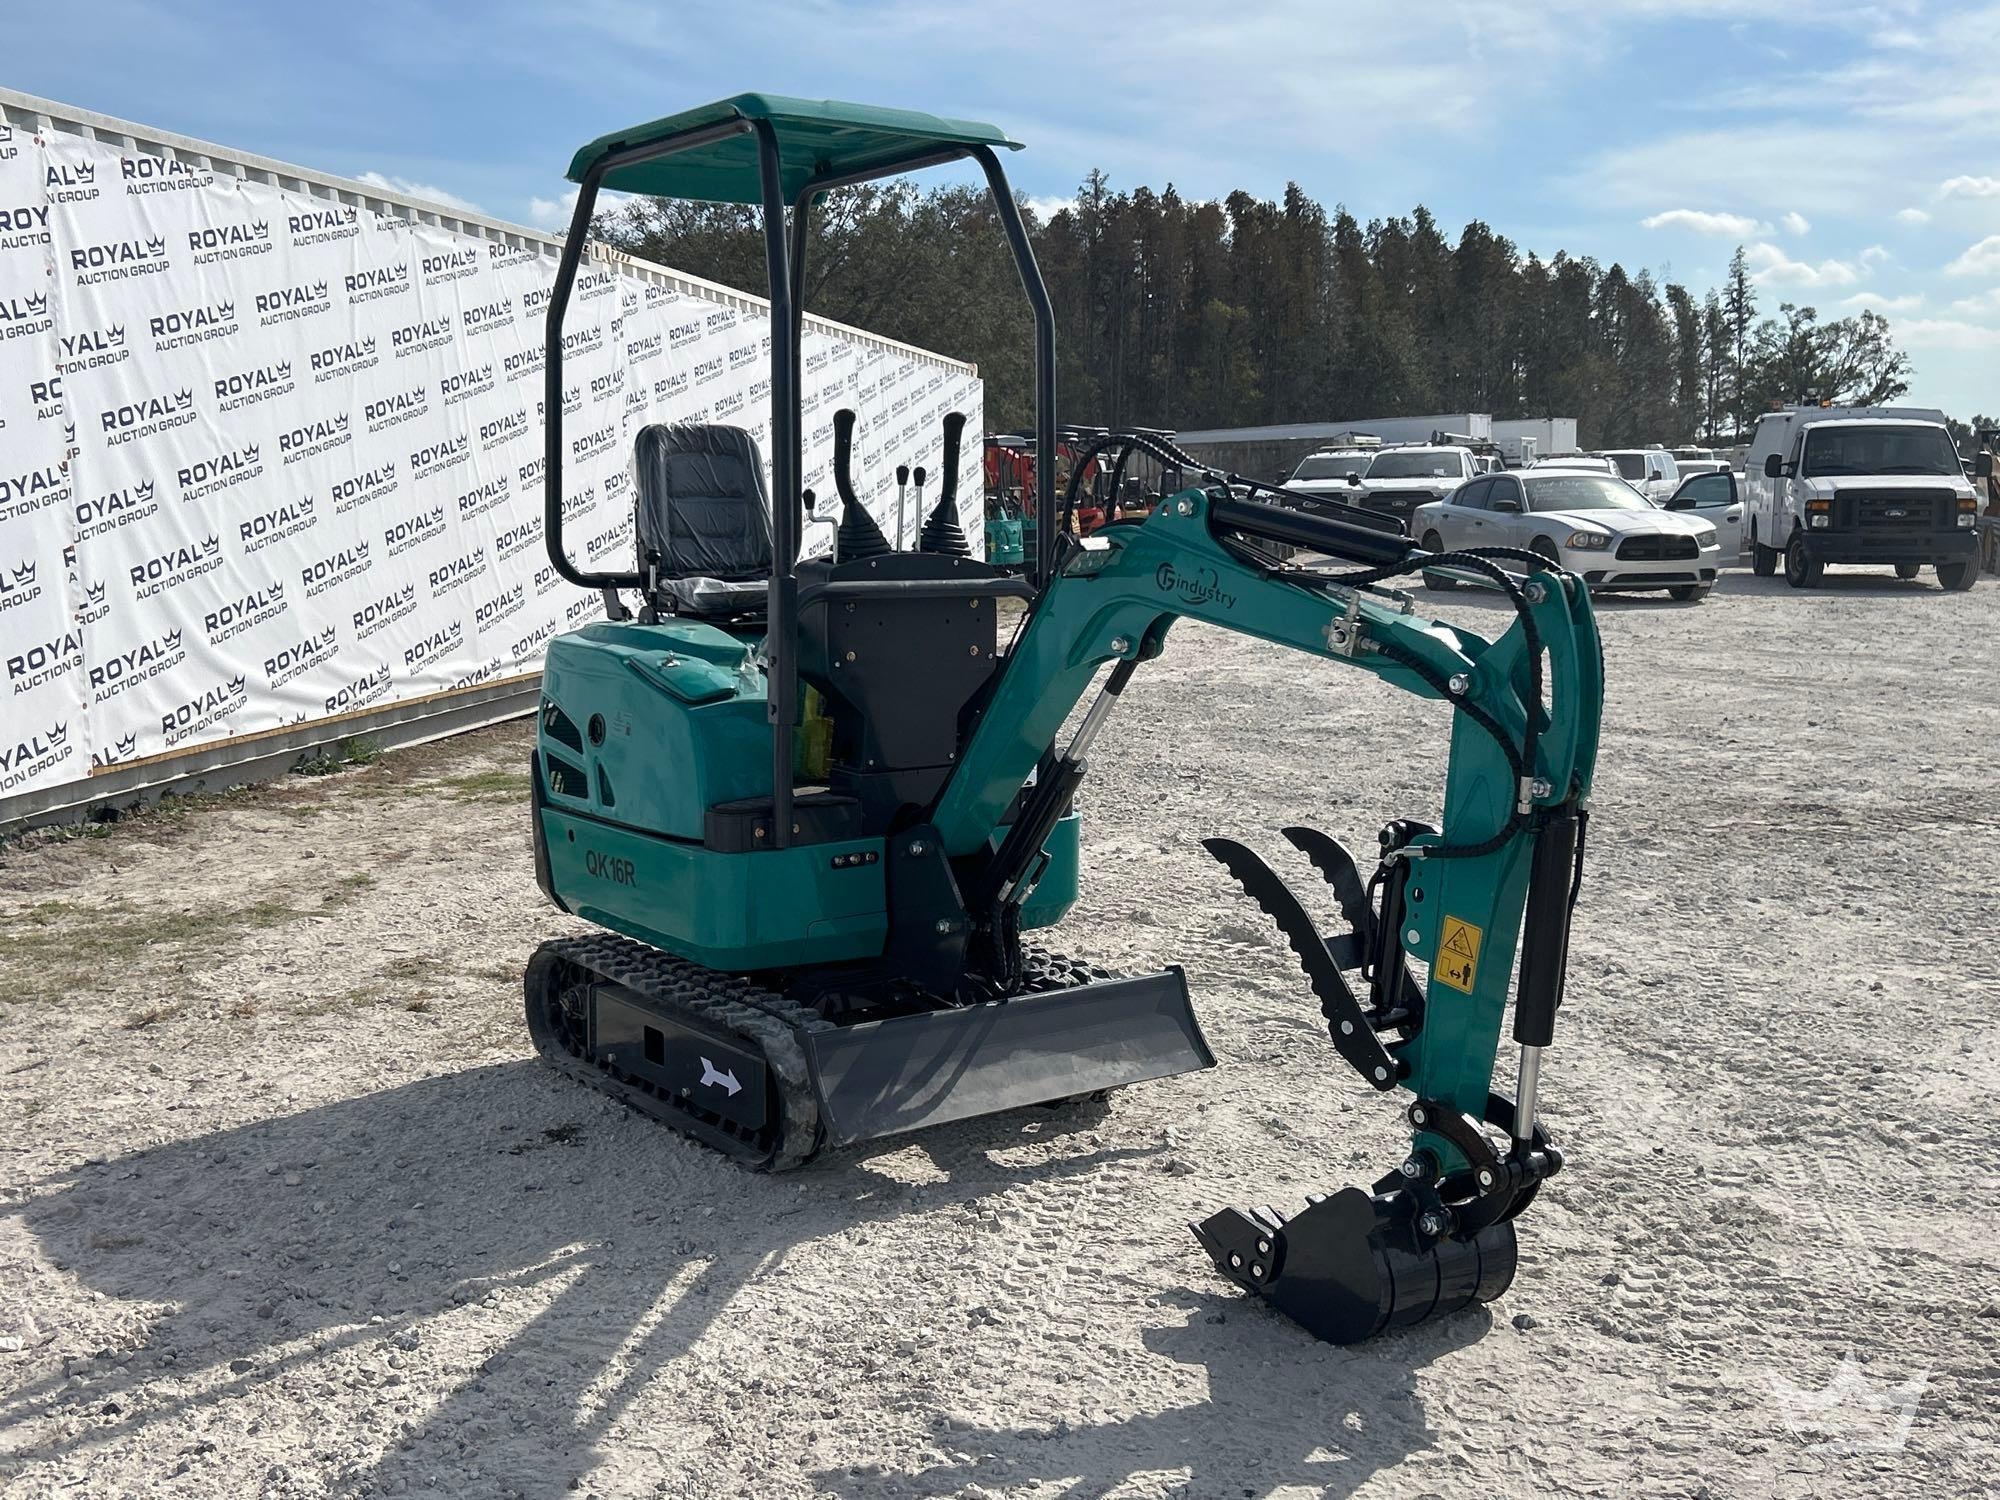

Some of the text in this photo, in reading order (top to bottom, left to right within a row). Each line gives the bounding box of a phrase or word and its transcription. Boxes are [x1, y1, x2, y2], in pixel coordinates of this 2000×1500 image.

[58, 189, 99, 203] GROUP
[126, 176, 213, 195] AUCTION GROUP
[288, 210, 344, 234] ROYAL
[188, 224, 254, 250] ROYAL
[293, 227, 359, 247] AUCTION GROUP
[71, 241, 148, 270] ROYAL
[194, 243, 272, 266] AUCTION GROUP
[422, 252, 466, 274] ROYAL
[77, 261, 170, 286] AUCTION GROUP
[345, 267, 395, 292] ROYAL
[426, 267, 478, 286] AUCTION GROUP
[578, 272, 610, 291] ROYAL
[256, 285, 314, 313] ROYAL
[349, 283, 410, 306] AUCTION GROUP
[580, 290, 602, 302] AUCTION
[6, 319, 53, 338] GROUP
[150, 306, 219, 337] ROYAL
[260, 302, 330, 327] AUCTION GROUP
[463, 302, 503, 326] ROYAL
[467, 316, 514, 336] AUCTION GROUP
[707, 311, 729, 327] ROYAL
[156, 324, 238, 352] AUCTION GROUP
[392, 321, 440, 346] ROYAL
[670, 323, 694, 340] ROYAL
[89, 350, 129, 368] GROUP
[310, 342, 364, 370] ROYAL
[396, 335, 453, 359] AUCTION GROUP
[504, 348, 539, 372] ROYAL
[585, 341, 603, 353] GROUP
[627, 337, 655, 356] ROYAL
[629, 354, 647, 366] AUCTION
[729, 346, 751, 362] ROYAL
[215, 367, 278, 399] ROYAL
[315, 357, 379, 384] AUCTION GROUP
[441, 369, 483, 395] ROYAL
[507, 369, 531, 383] AUCTION
[694, 359, 717, 378] ROYAL
[220, 382, 295, 413] AUCTION GROUP
[444, 381, 494, 407] AUCTION GROUP
[654, 375, 680, 394] ROYAL
[101, 396, 176, 432] ROYAL
[365, 393, 414, 421] ROYAL
[564, 402, 582, 415] GROUP
[715, 395, 737, 413] ROYAL
[107, 412, 196, 448] AUCTION GROUP
[369, 405, 428, 434] AUCTION GROUP
[480, 414, 517, 441] ROYAL
[279, 420, 335, 452] ROYAL
[283, 433, 352, 466] AUCTION GROUP
[483, 426, 528, 452] AUCTION GROUP
[573, 430, 606, 454] ROYAL
[410, 440, 457, 469] ROYAL
[575, 439, 616, 464] AUCTION GROUP
[177, 452, 244, 488] ROYAL
[414, 452, 470, 481] AUCTION GROUP
[183, 466, 263, 503] AUCTION GROUP
[332, 470, 383, 502] ROYAL
[336, 482, 398, 515] AUCTION GROUP
[458, 482, 498, 511] ROYAL
[76, 489, 136, 524] OYAL
[118, 504, 158, 526] GROUP
[462, 492, 510, 523] AUCTION GROUP
[240, 504, 300, 541] ROYAL
[244, 516, 317, 555] AUCTION GROUP
[385, 513, 432, 546] ROYAL
[496, 522, 533, 552] ROYAL
[388, 523, 446, 558] AUCTION GROUP
[499, 532, 543, 563] AUCTION GROUP
[587, 527, 620, 554] ROYAL
[130, 544, 203, 586] ROYAL
[302, 550, 356, 586] ROYAL
[590, 547, 612, 564] AUCTION
[136, 557, 223, 602] AUCTION GROUP
[306, 560, 372, 599] AUCTION GROUP
[429, 555, 474, 588] ROYAL
[432, 564, 486, 599] AUCTION GROUP
[205, 591, 269, 633] ROYAL
[353, 592, 402, 629] ROYAL
[475, 591, 514, 624] ROYAL
[479, 599, 525, 635] AUCTION GROUP
[566, 592, 600, 621] ROYAL
[570, 612, 592, 630] AUCTION
[211, 602, 288, 647] AUCTION GROUP
[357, 602, 417, 642] AUCTION GROUP
[6, 633, 78, 680] ROYA
[404, 629, 450, 666] ROYAL
[512, 626, 548, 658] ROYAL
[89, 640, 165, 689] ROYAL
[264, 636, 323, 678] ROYAL
[271, 645, 342, 691] AUCTION GROUP
[410, 637, 463, 677] AUCTION GROUP
[14, 660, 71, 696] AUCTION
[95, 651, 185, 704] AUCTION GROUP
[366, 681, 392, 703] GROUP
[325, 675, 378, 713] ROYAL
[162, 687, 228, 734] ROYAL
[166, 696, 247, 748] AUCTION GROUP
[28, 746, 72, 777] GROUP
[586, 850, 636, 888] QK16R
